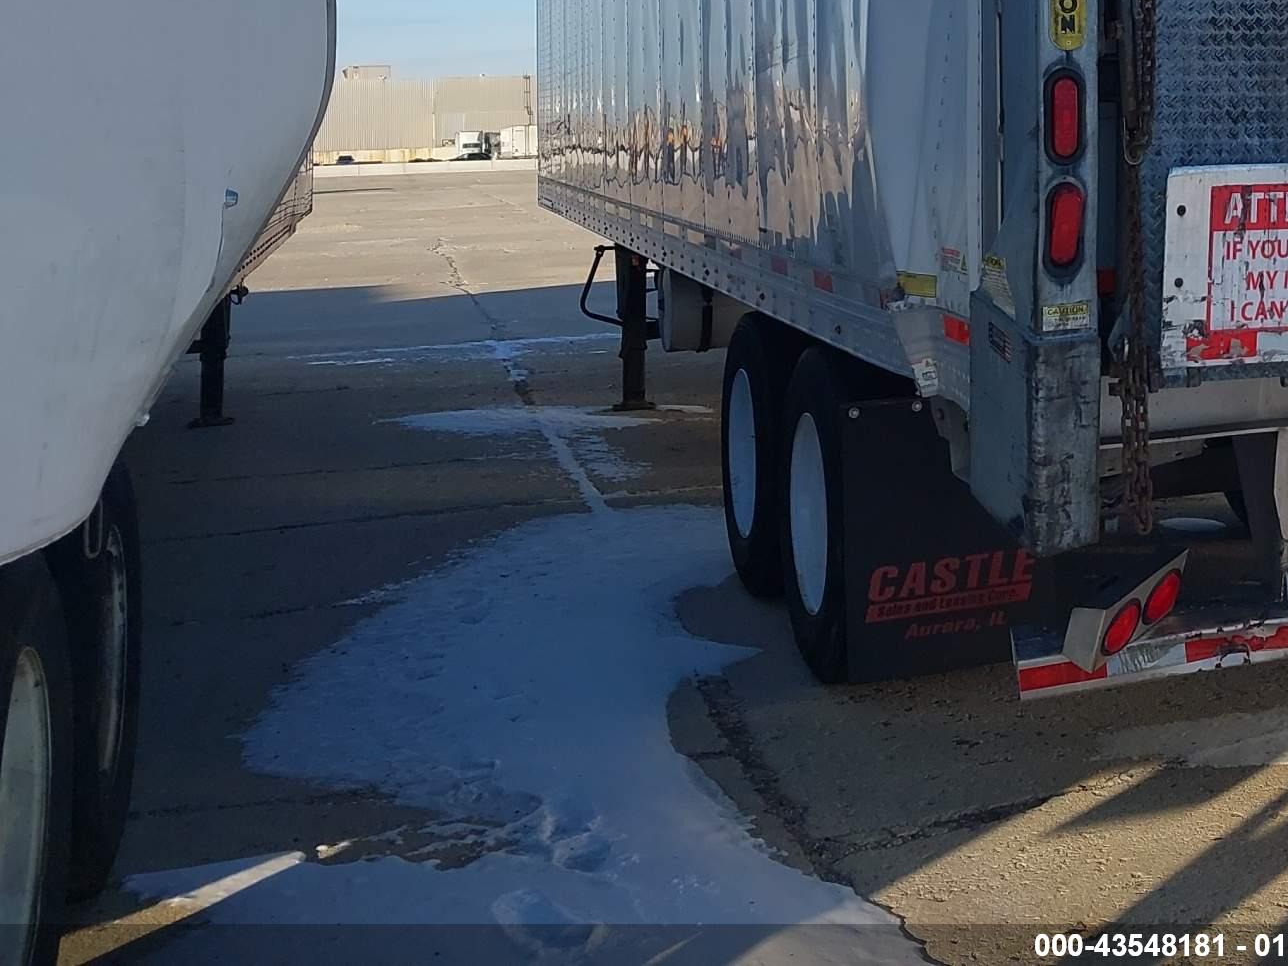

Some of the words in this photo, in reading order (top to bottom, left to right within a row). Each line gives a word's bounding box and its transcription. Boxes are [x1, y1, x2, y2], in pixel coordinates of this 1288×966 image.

[1226, 242, 1242, 260] IF
[1246, 271, 1279, 291] MY
[867, 548, 1035, 601] CASTLE
